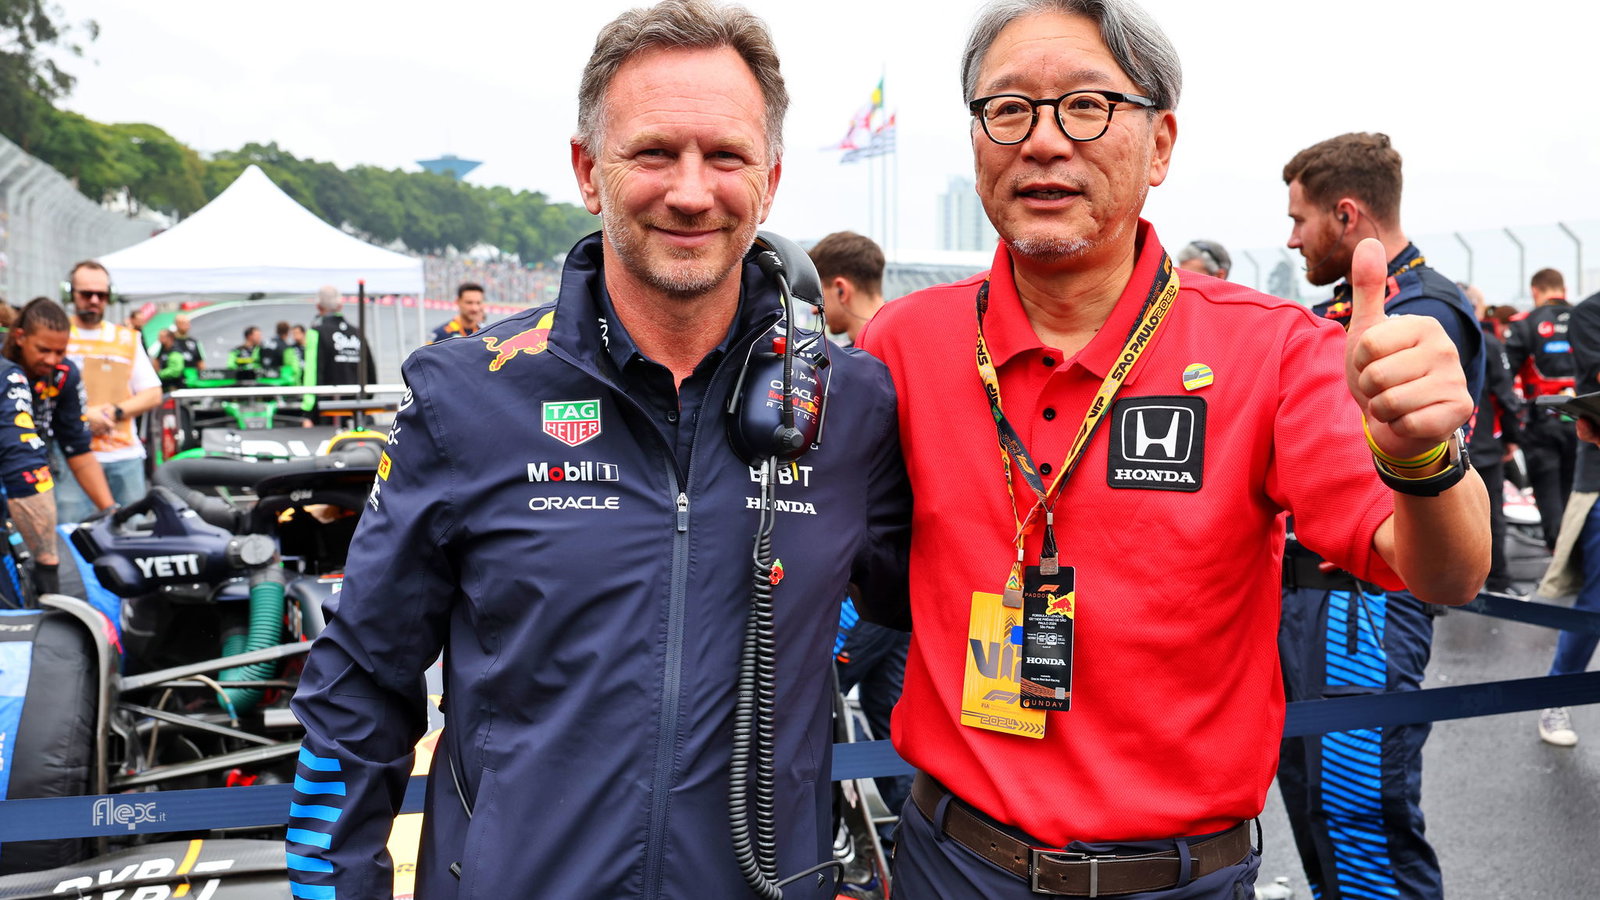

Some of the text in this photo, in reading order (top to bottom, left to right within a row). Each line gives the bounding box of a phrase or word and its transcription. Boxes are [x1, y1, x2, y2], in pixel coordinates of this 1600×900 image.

[1130, 316, 1159, 354] PAULO
[770, 380, 820, 406] OACLE
[548, 404, 596, 420] TAG
[766, 401, 817, 424] RAING
[1089, 396, 1105, 418] VIP
[547, 422, 597, 444] HEUER
[527, 461, 593, 482] Mobil
[749, 462, 813, 487] BBIT
[1115, 469, 1196, 484] HONDA
[528, 496, 620, 511] ORACLE
[745, 497, 817, 515] HNDA
[135, 554, 199, 579] YETI
[1026, 656, 1066, 666] HONDA
[1031, 700, 1063, 708] UNDAY
[981, 714, 1017, 730] 2024
